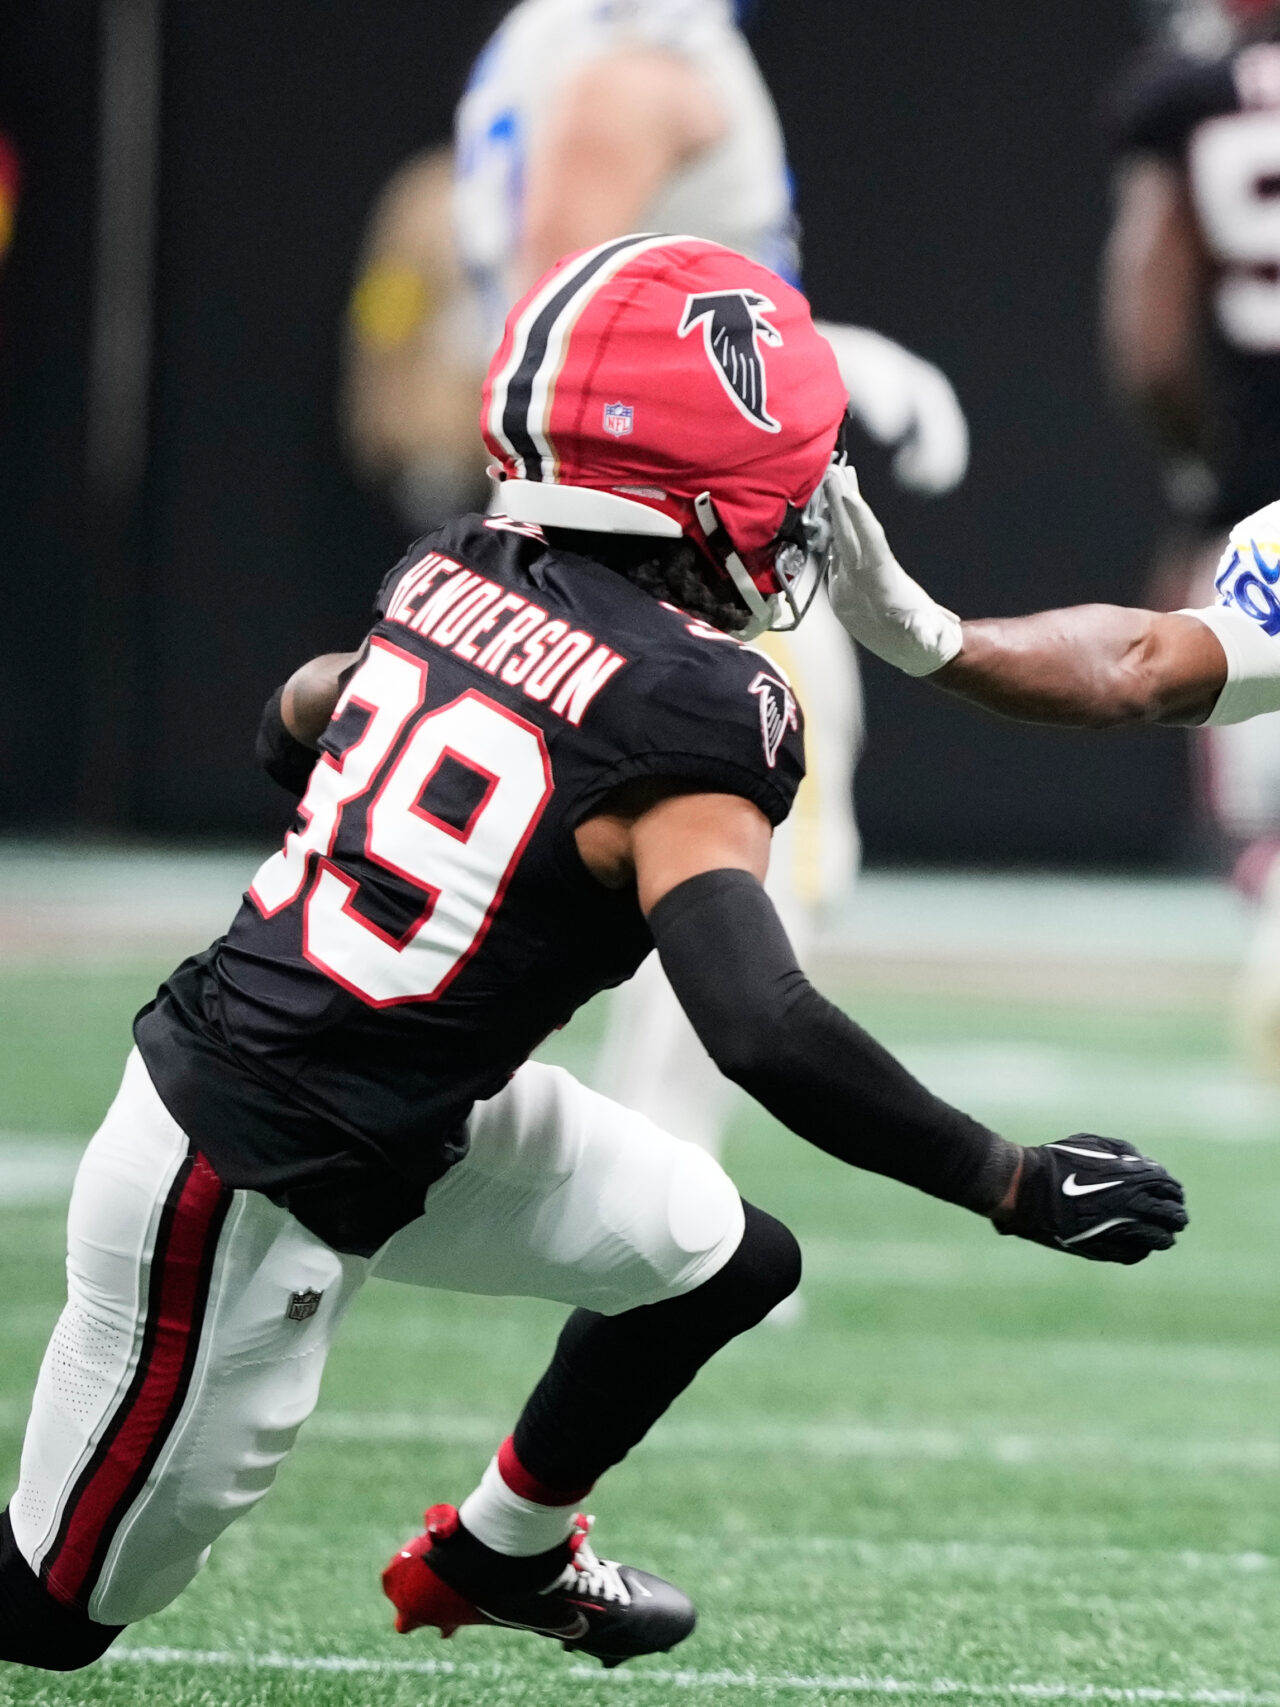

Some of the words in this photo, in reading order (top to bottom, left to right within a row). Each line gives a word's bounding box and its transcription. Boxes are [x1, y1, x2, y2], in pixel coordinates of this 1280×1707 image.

[608, 416, 631, 432] NFL
[384, 551, 627, 728] HENDERSON
[248, 635, 555, 1009] 39
